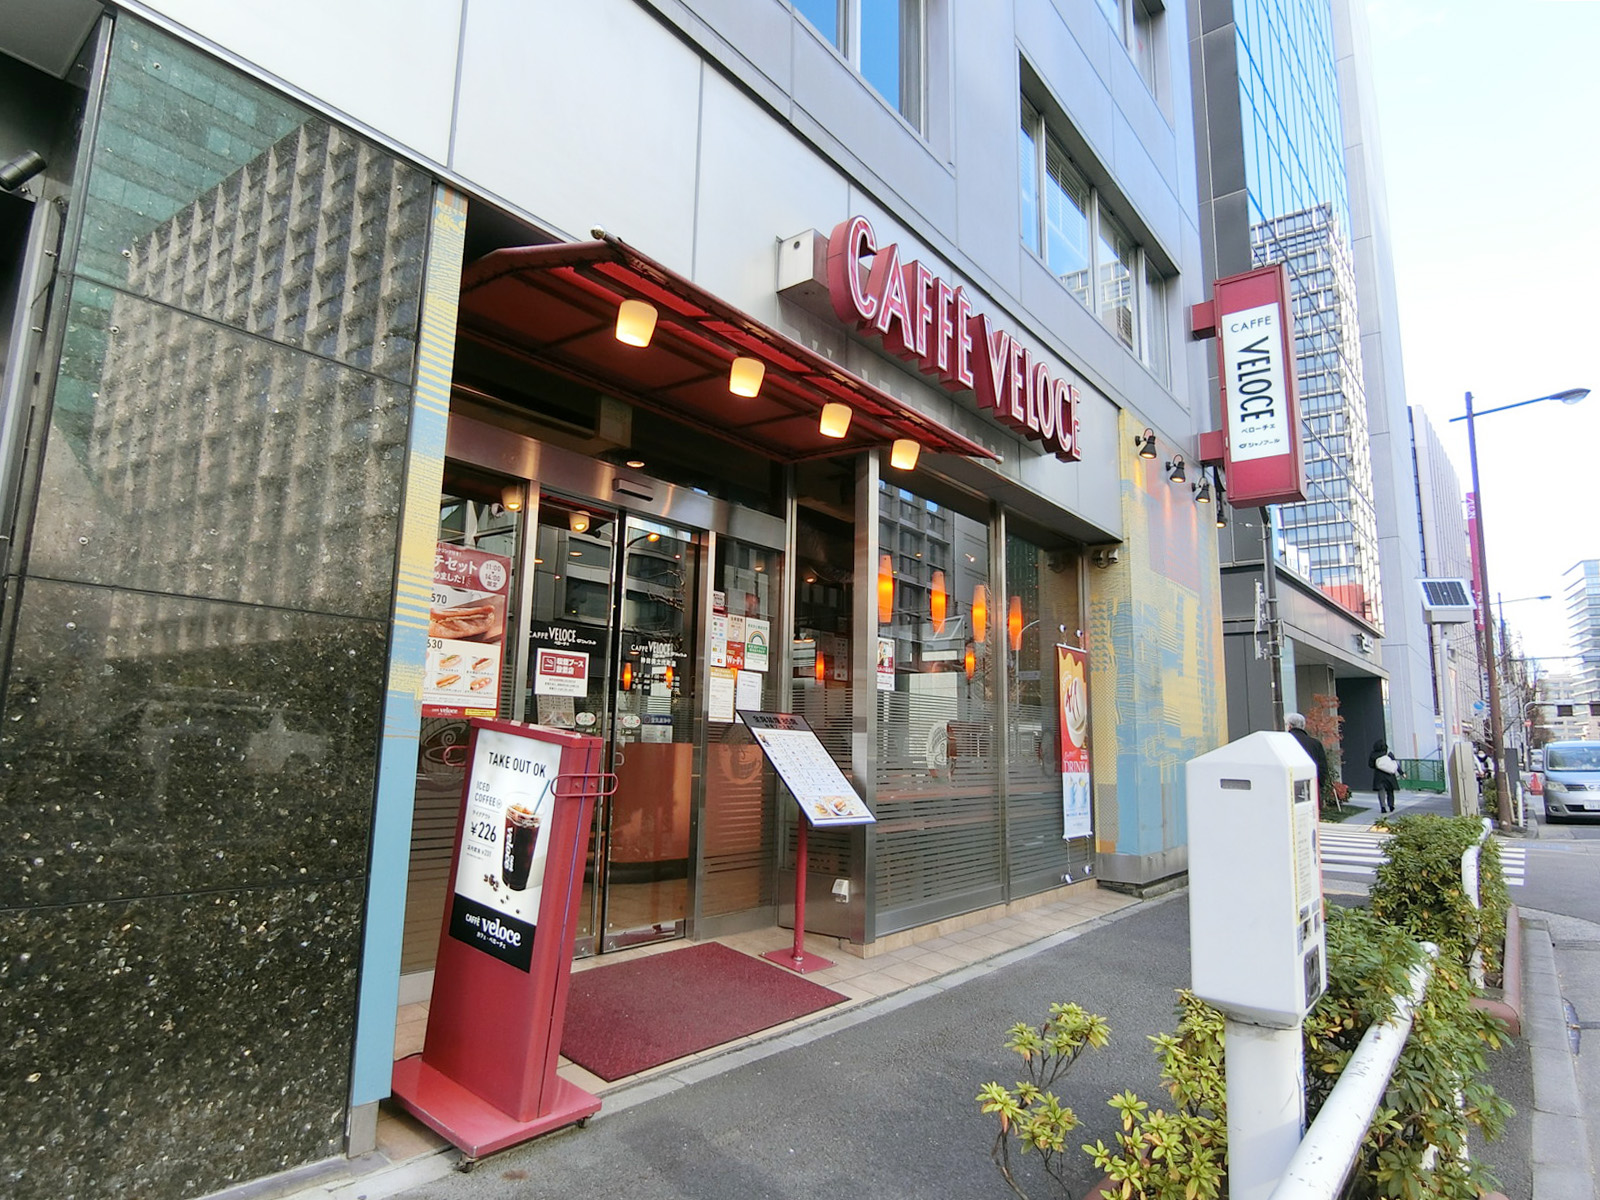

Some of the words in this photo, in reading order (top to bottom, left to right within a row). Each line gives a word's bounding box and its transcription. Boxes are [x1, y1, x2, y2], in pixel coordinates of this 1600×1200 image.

[1230, 315, 1272, 334] CAFFE
[975, 313, 1083, 462] VELOCE
[1236, 335, 1275, 423] VELOCE
[485, 563, 502, 573] 11:00
[484, 573, 501, 583] 14:00
[548, 626, 577, 643] VELOCE
[648, 640, 671, 656] VELOCE
[726, 654, 744, 666] Wi-Fi
[488, 751, 511, 770] TAKE
[512, 757, 532, 775] OUT
[533, 763, 547, 778] OK
[476, 780, 491, 793] ICED
[474, 792, 497, 808] COFFEE
[470, 820, 498, 843] ¥226
[503, 826, 514, 872] veloce
[465, 913, 481, 927] CAFFÈ
[481, 917, 522, 947] veloce
